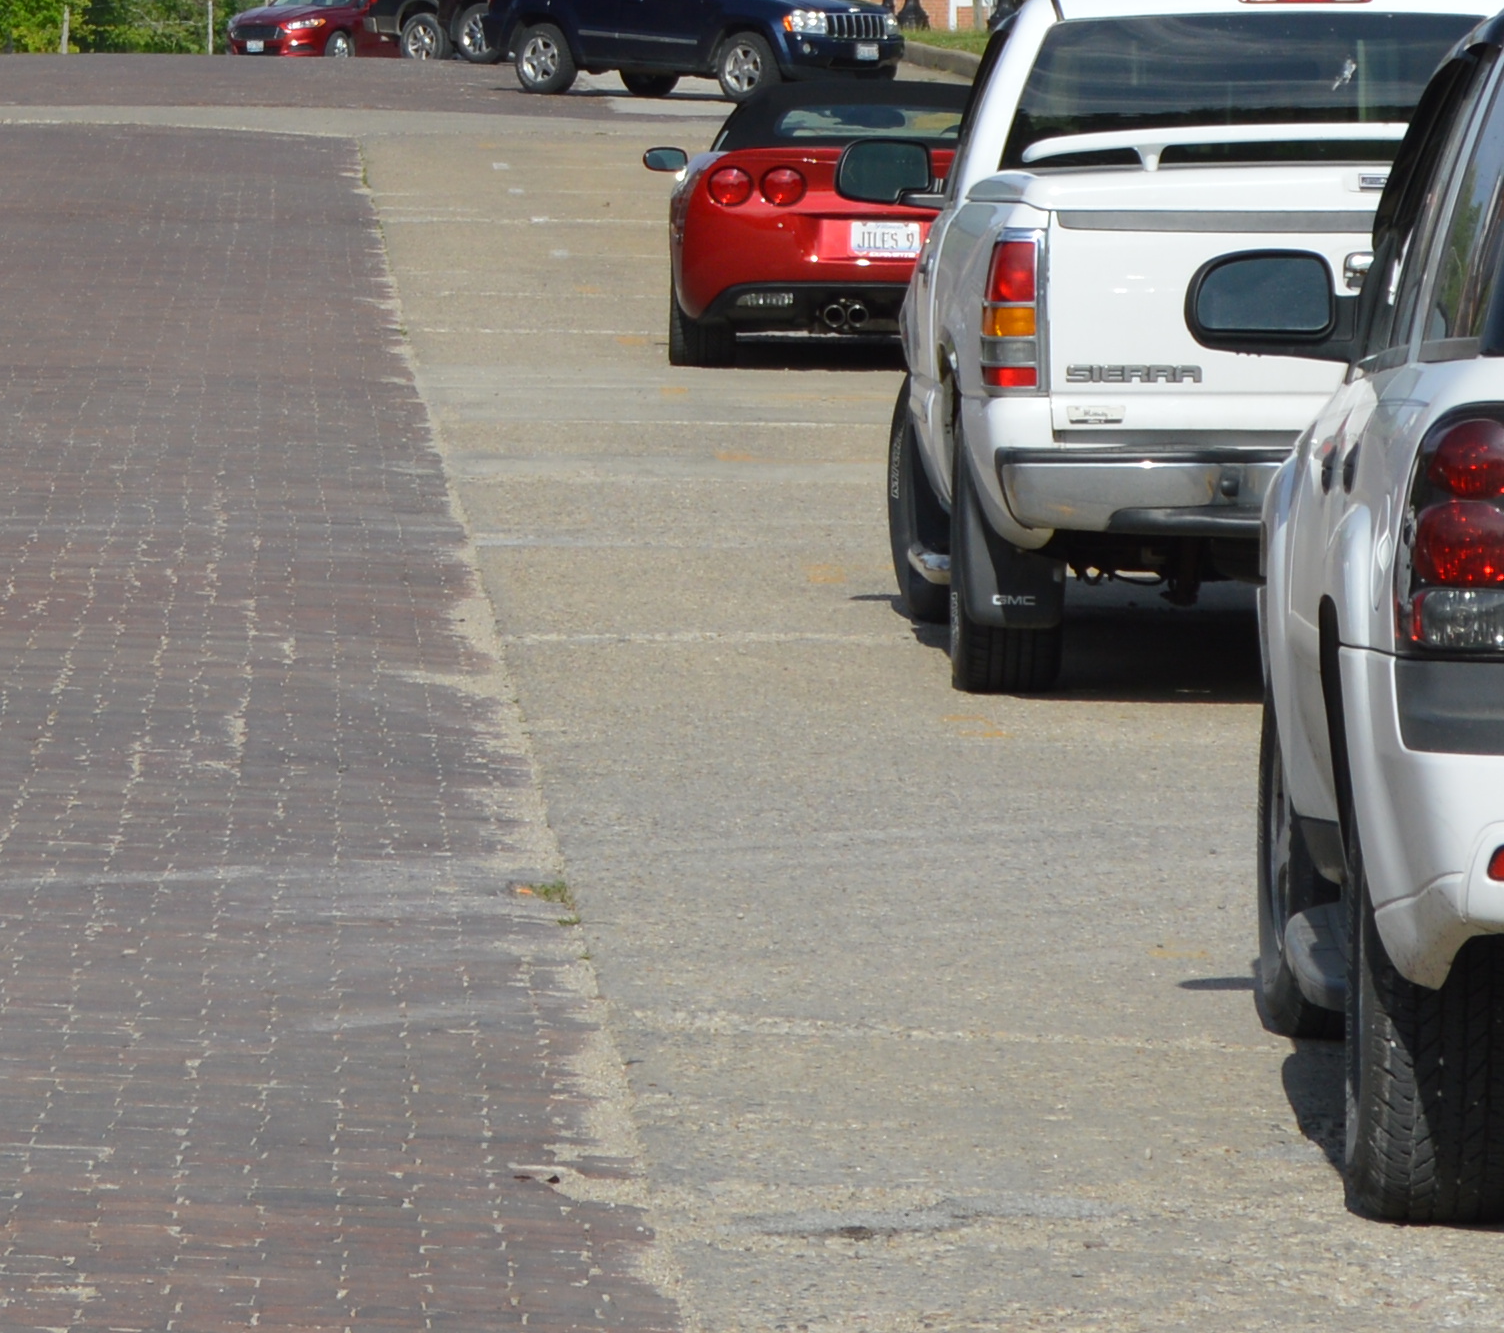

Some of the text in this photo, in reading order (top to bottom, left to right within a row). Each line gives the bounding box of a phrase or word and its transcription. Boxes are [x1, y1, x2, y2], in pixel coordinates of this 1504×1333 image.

[857, 231, 898, 250] JILES
[1066, 364, 1202, 383] SIERRA
[991, 594, 1036, 606] GMC
